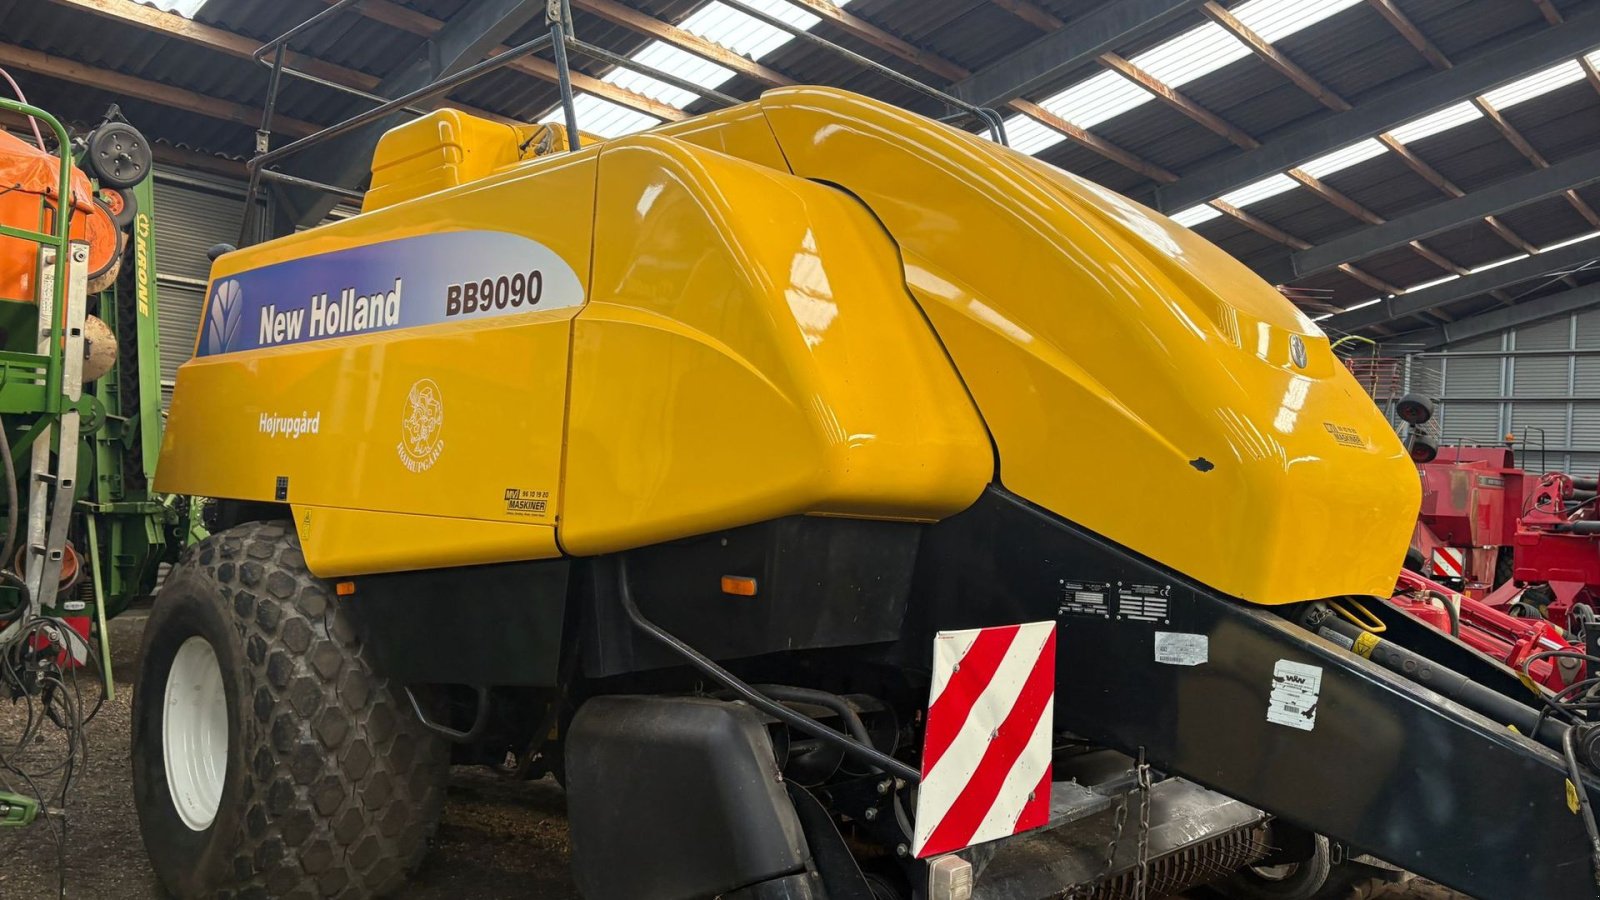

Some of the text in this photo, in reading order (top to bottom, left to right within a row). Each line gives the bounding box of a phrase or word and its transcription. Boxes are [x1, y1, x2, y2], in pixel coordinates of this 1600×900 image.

[137, 236, 149, 317] KRONE
[446, 270, 543, 317] BB9090
[259, 277, 402, 345] New Holland
[259, 410, 320, 439] Højrupgård
[509, 500, 546, 511] MASKINER
